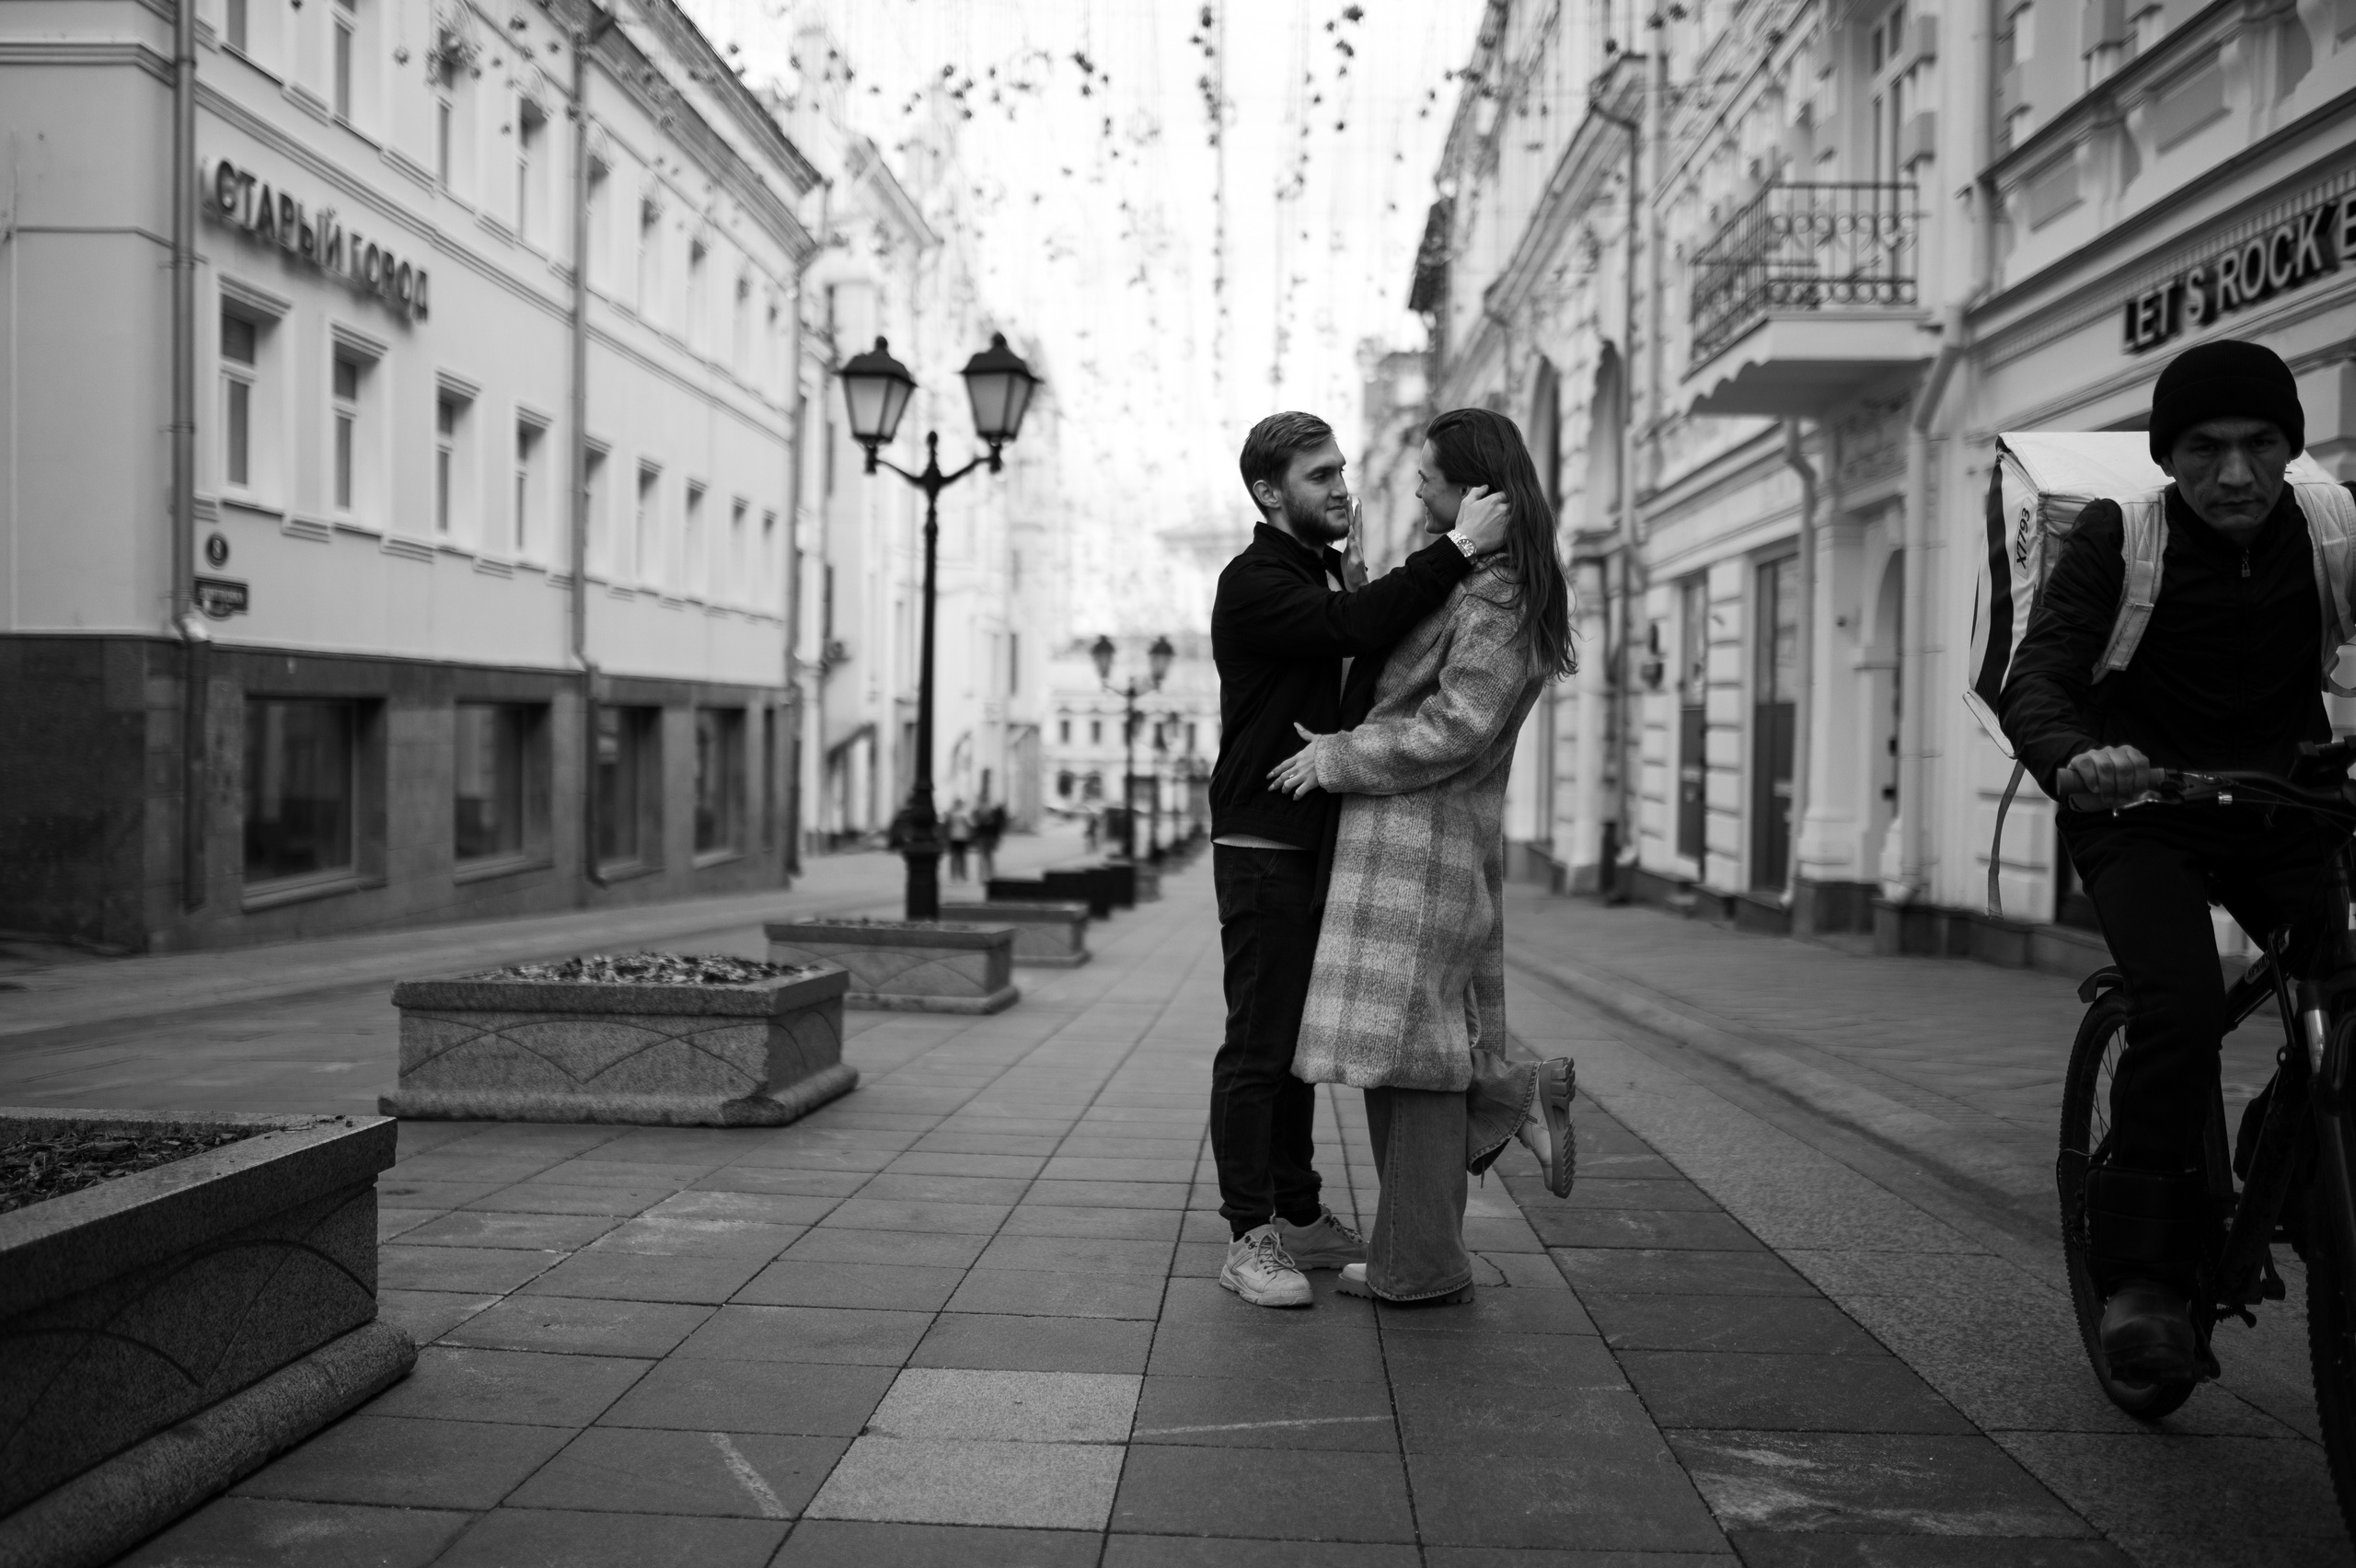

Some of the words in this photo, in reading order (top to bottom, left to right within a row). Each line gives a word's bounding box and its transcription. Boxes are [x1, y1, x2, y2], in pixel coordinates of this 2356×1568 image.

[216, 159, 343, 276] СТАРЫЙ
[348, 232, 429, 323] ГОРОД
[2215, 213, 2325, 311] ROCK
[2016, 507, 2030, 570] X7793
